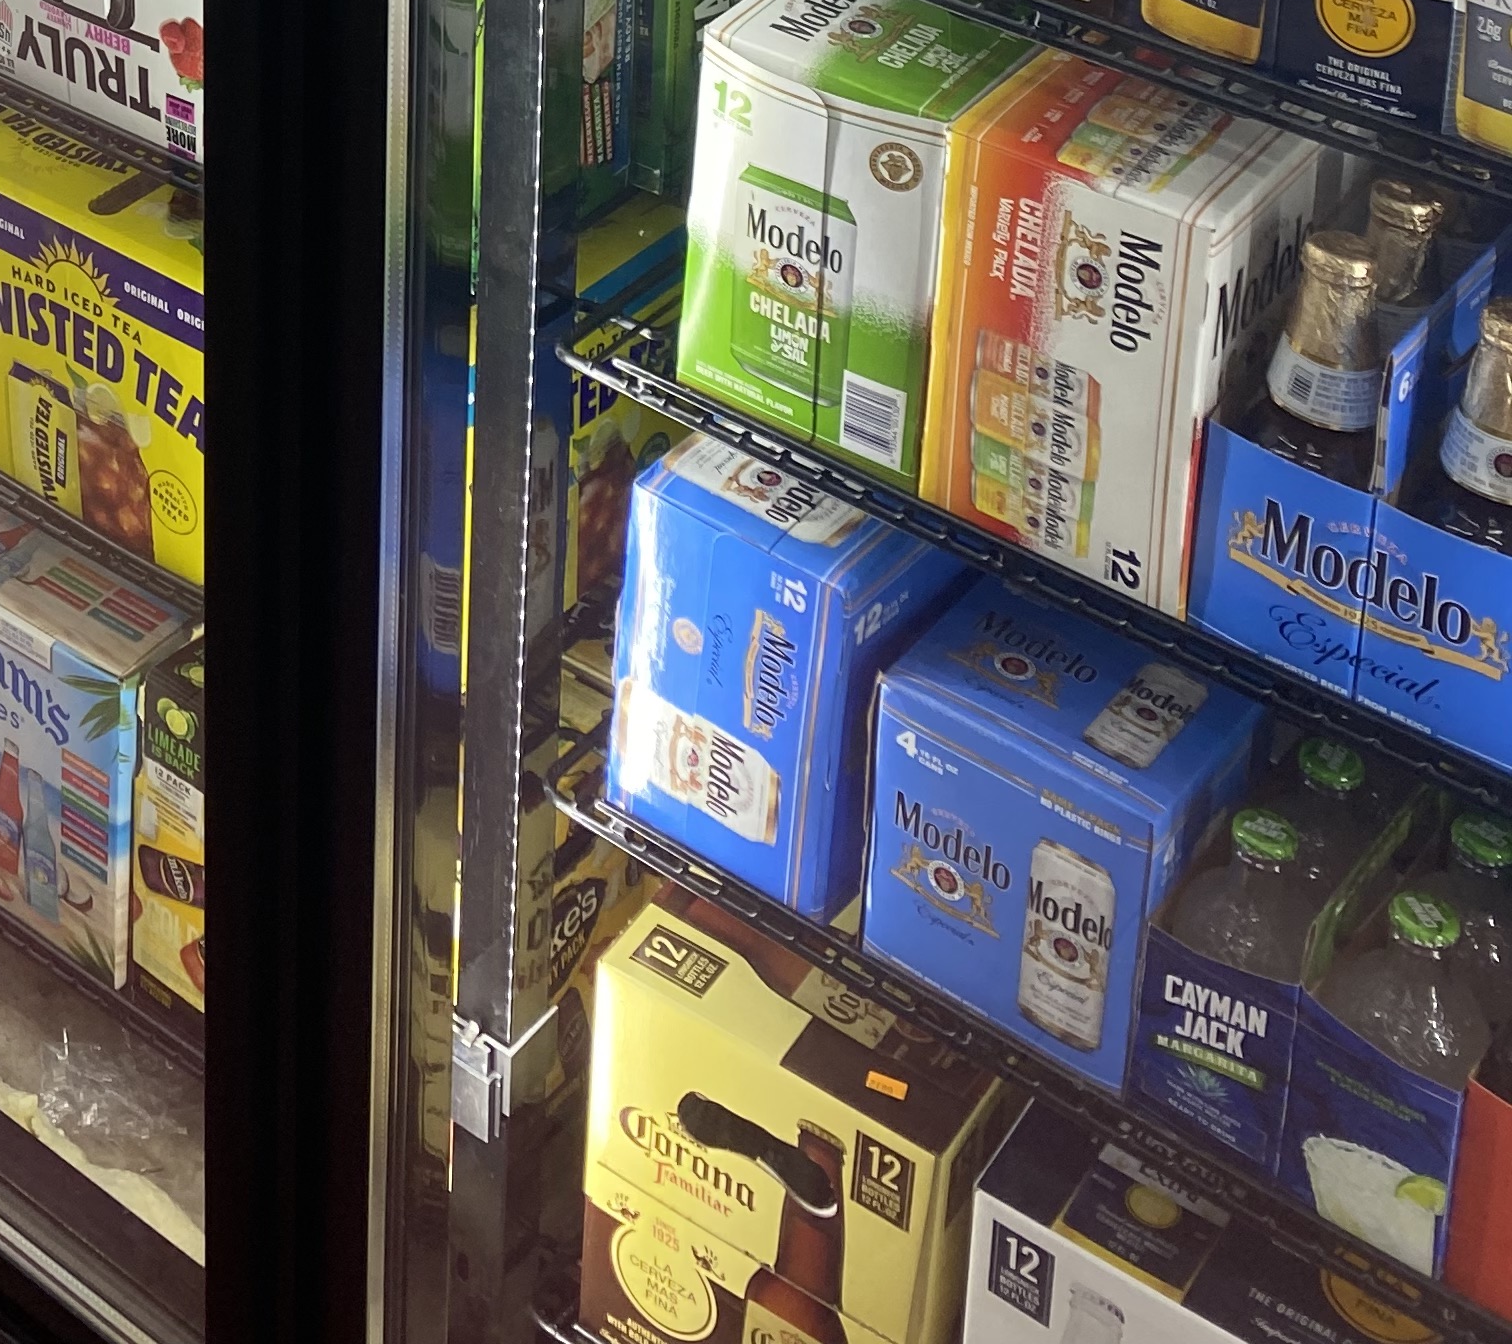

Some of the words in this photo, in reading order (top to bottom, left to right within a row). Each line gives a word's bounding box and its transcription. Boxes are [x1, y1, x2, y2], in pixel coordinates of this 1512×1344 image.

[84, 22, 130, 54] BERRY
[17, 14, 162, 121] TRULY
[713, 79, 754, 118] 12
[745, 203, 844, 275] Modelo
[11, 264, 58, 296] HARD
[63, 285, 104, 319] ICED
[110, 314, 143, 345] TEA
[123, 281, 170, 314] ORIGINAL
[1109, 229, 1164, 355] Modelo
[749, 292, 831, 344] CHELADA
[134, 355, 204, 456] TEA
[153, 488, 189, 521] BREWED
[1111, 546, 1142, 591] 12
[1259, 497, 1473, 648] Modelo
[784, 578, 808, 614] 12
[755, 630, 795, 729] Modelo
[1267, 602, 1438, 708] Especial
[896, 730, 918, 760] 4
[1388, 704, 1432, 735] MEXICO
[148, 722, 201, 772] LIMEADE
[151, 742, 164, 756] IS
[164, 749, 196, 781] BACK
[894, 790, 1011, 892] Modelo
[643, 934, 688, 968] 12
[1165, 974, 1268, 1038] CAYMAN
[1156, 1033, 1260, 1084] MARGARITA
[1176, 1013, 1246, 1059] JACK
[618, 1104, 757, 1213] Corona
[867, 1146, 902, 1192] 12
[653, 1160, 732, 1219] Familiar
[630, 1253, 697, 1305] CERVEZA
[1006, 1236, 1041, 1284] 12
